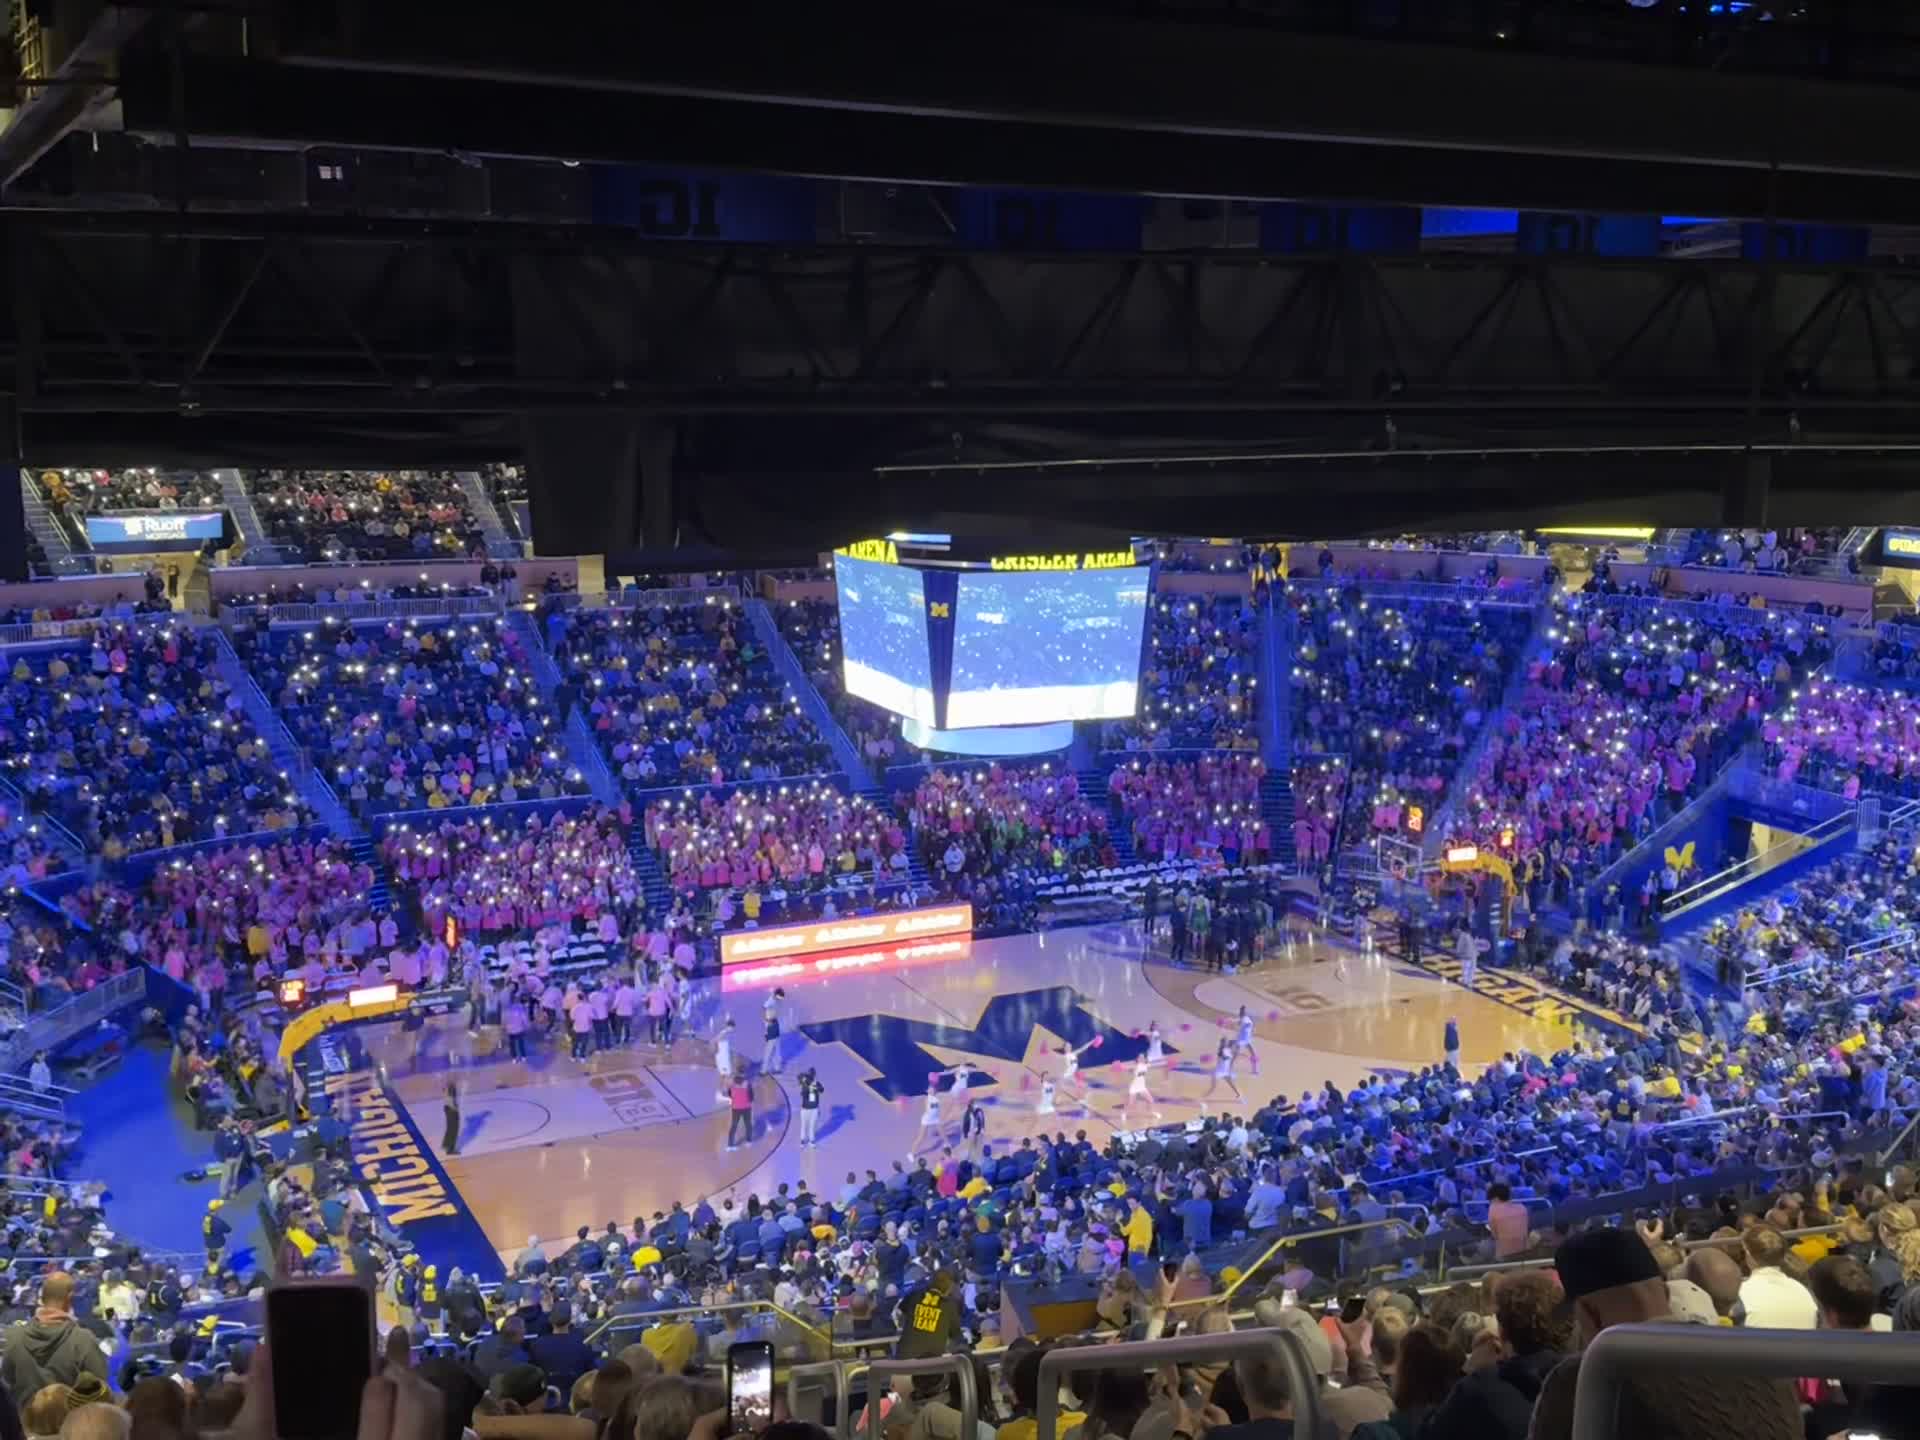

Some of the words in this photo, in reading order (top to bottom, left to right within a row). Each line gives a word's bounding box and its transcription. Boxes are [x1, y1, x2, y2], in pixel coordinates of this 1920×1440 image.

[324, 1069, 459, 1226] MICHIGAN
[914, 1304, 942, 1320] EVENT
[913, 1316, 938, 1333] TEAM
